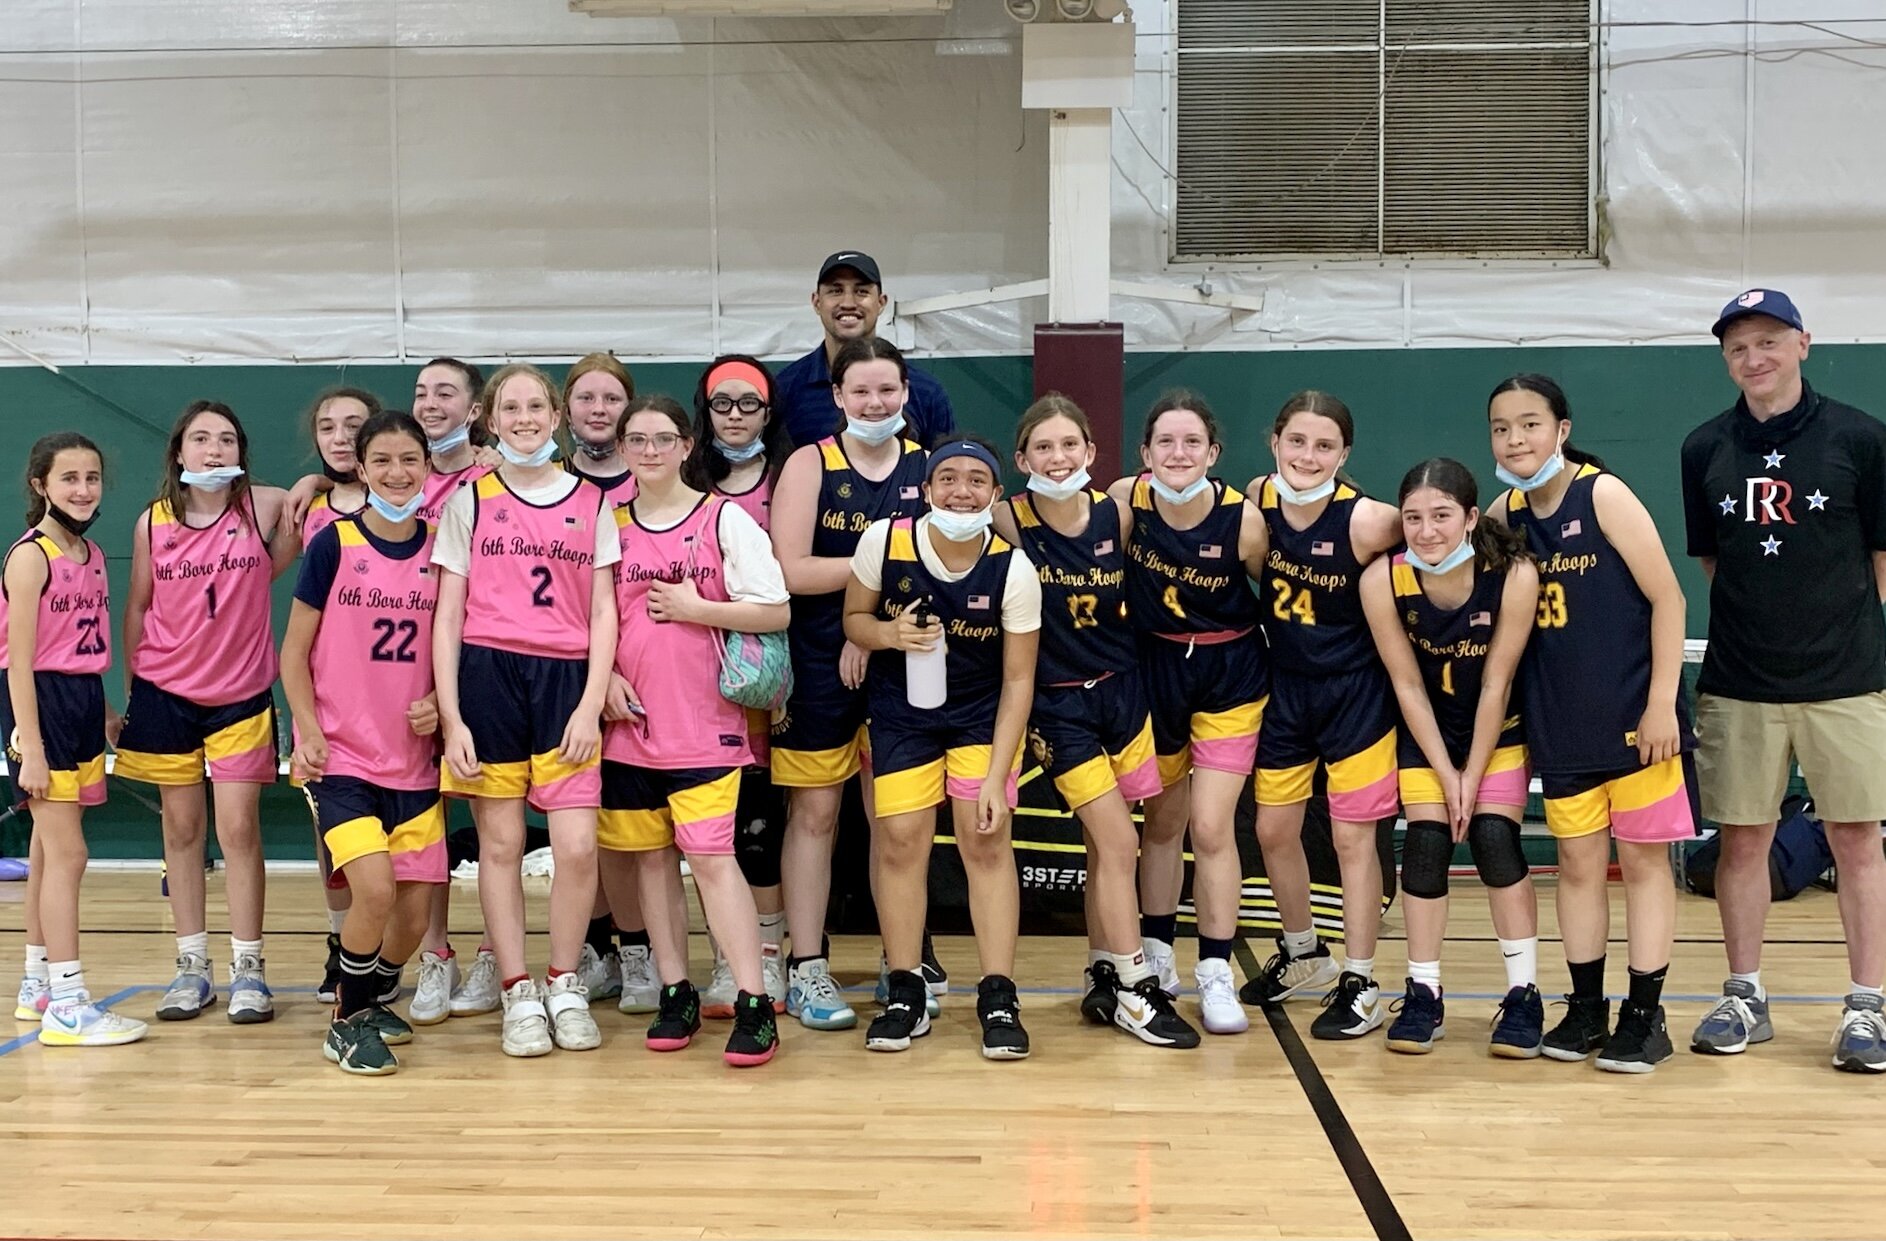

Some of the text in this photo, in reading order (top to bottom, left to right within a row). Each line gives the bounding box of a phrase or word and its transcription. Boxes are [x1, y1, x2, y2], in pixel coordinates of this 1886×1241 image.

[1744, 476, 1798, 525] RR
[822, 508, 872, 533] 6th Bo
[178, 559, 214, 580] Boro
[217, 552, 261, 574] Hoops
[480, 536, 505, 557] 6th
[547, 540, 595, 570] Hoops
[1548, 551, 1598, 577] Hoops
[530, 565, 555, 608] 2
[625, 562, 665, 583] Boro
[1087, 566, 1125, 590] Hoop
[1143, 549, 1178, 579] Boro
[1178, 566, 1230, 593] Hoops
[1267, 549, 1299, 577] Boro
[1300, 564, 1347, 593] Hoops
[50, 593, 71, 613] 6th
[205, 582, 217, 620] 1
[337, 587, 434, 612] 6th Boro Hoo
[1271, 576, 1317, 627] 24
[371, 617, 418, 663] 22
[946, 618, 1000, 642] Hoops
[1455, 638, 1488, 659] Hoo
[1441, 660, 1455, 696] 1
